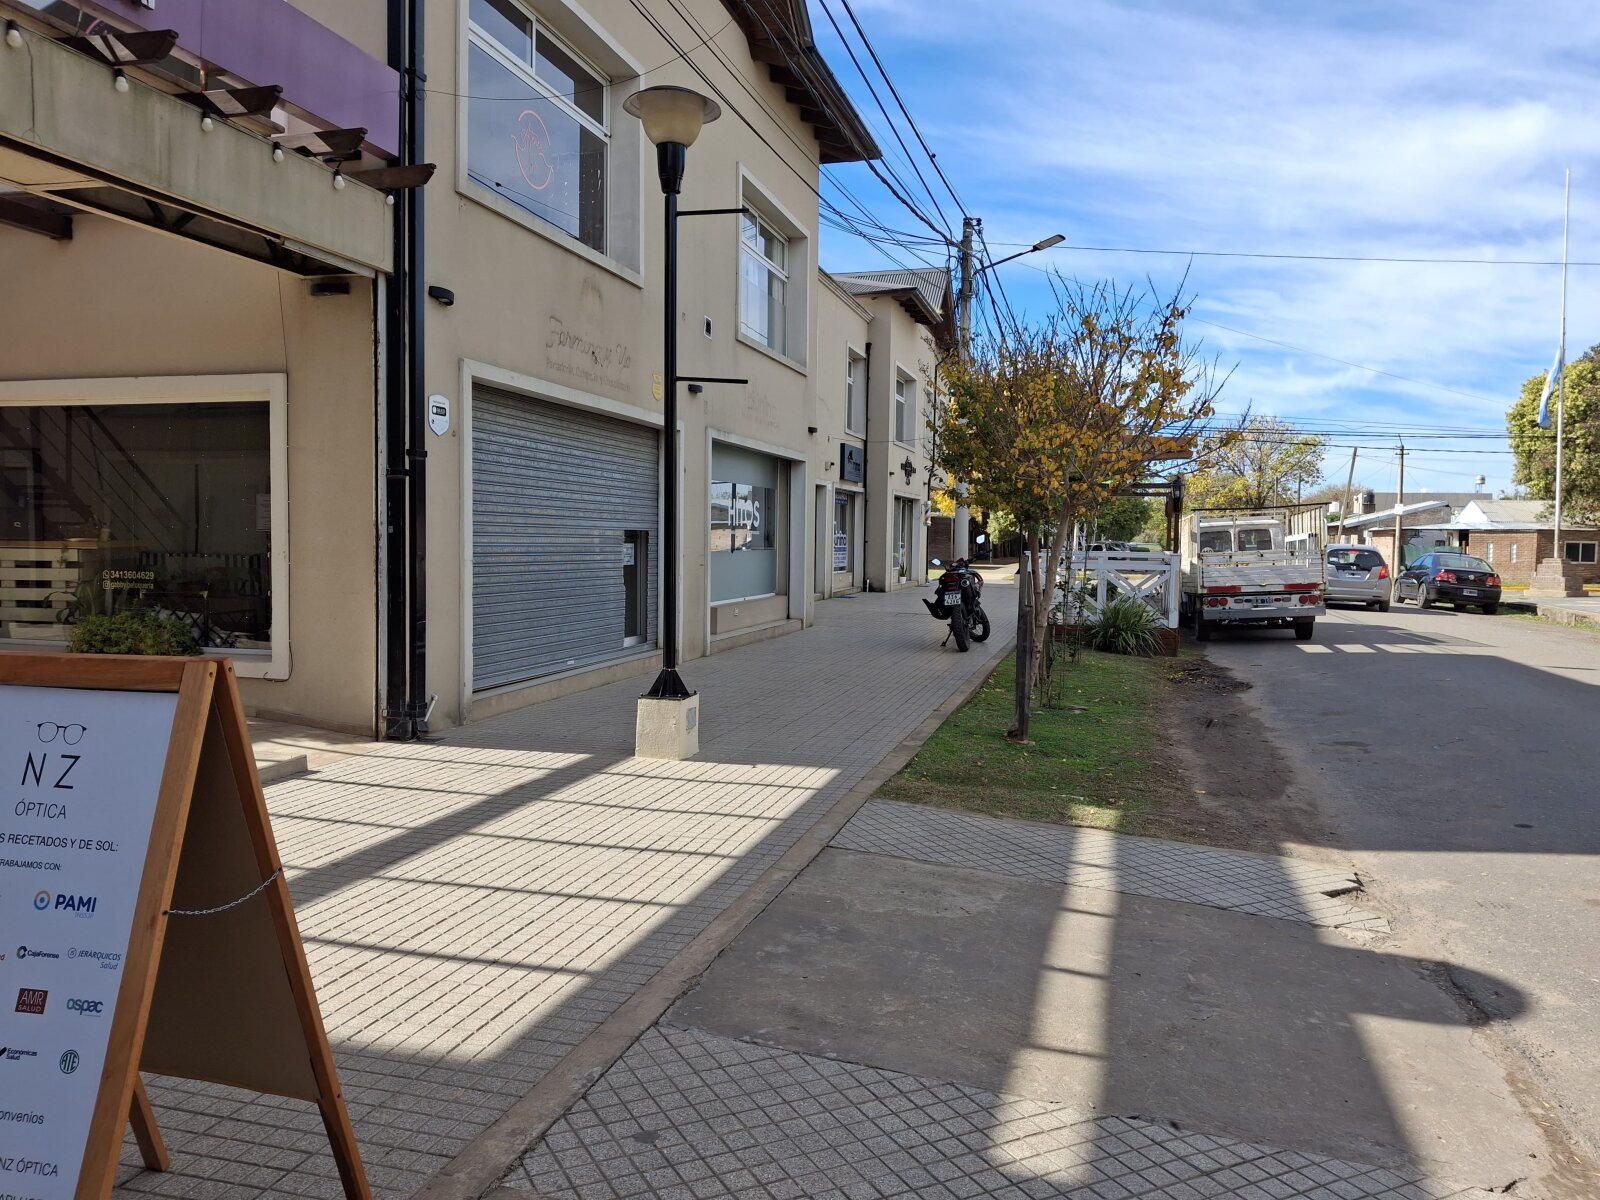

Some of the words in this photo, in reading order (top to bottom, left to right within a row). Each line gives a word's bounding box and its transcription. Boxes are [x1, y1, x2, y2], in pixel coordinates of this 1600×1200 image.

[110, 570, 155, 580] 3413604629
[14, 798, 67, 820] ÓPTICA
[7, 833, 68, 848] RECETADOS
[70, 838, 77, 849] Y
[79, 839, 93, 850] DE
[95, 840, 119, 852] SOL:
[44, 862, 62, 871] CON:
[54, 894, 97, 913] PAMI
[100, 961, 118, 970] Salud
[20, 990, 44, 1005] AMR
[17, 1004, 42, 1013] SALUD
[66, 998, 104, 1016] ospac
[16, 1156, 58, 1177] ÓPTICA
